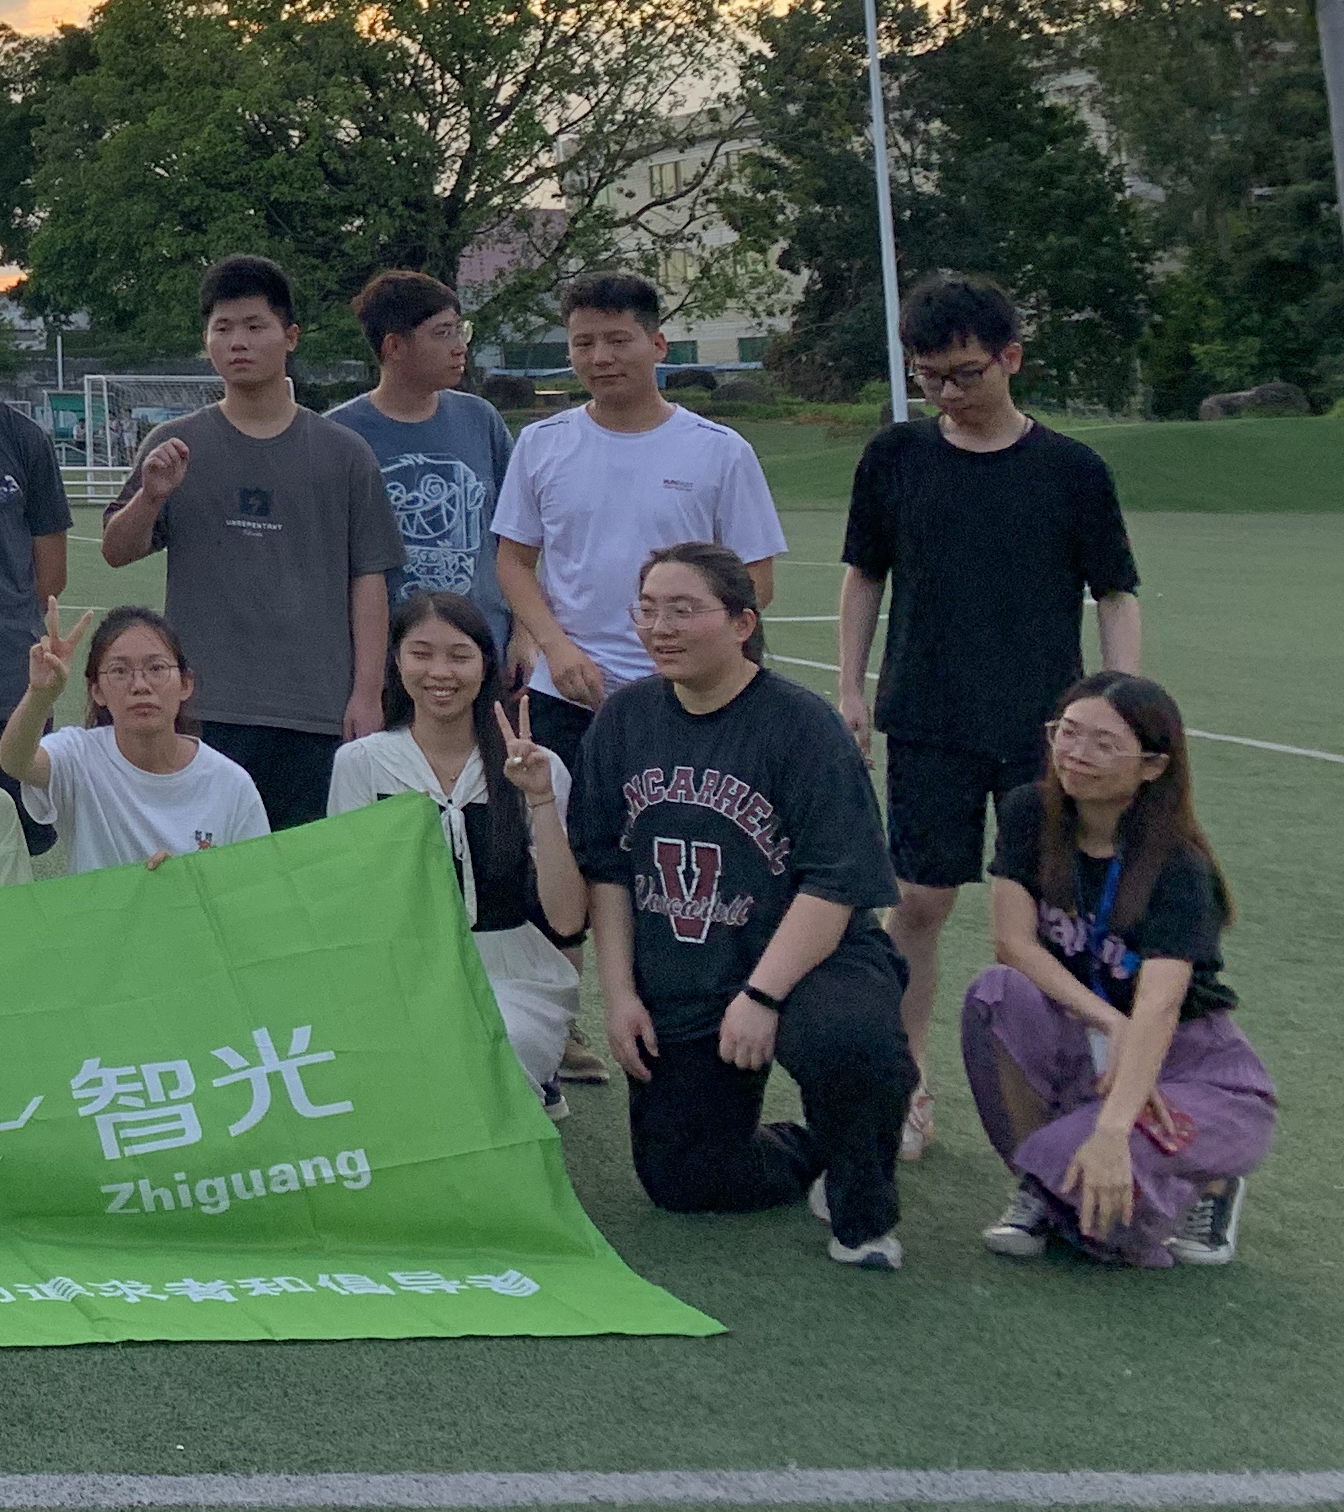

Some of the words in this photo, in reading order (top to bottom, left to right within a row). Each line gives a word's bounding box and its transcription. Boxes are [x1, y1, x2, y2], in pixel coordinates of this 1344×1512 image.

[654, 836, 721, 944] V
[70, 1024, 354, 1160] 智光
[100, 1148, 373, 1214] Zhiguang
